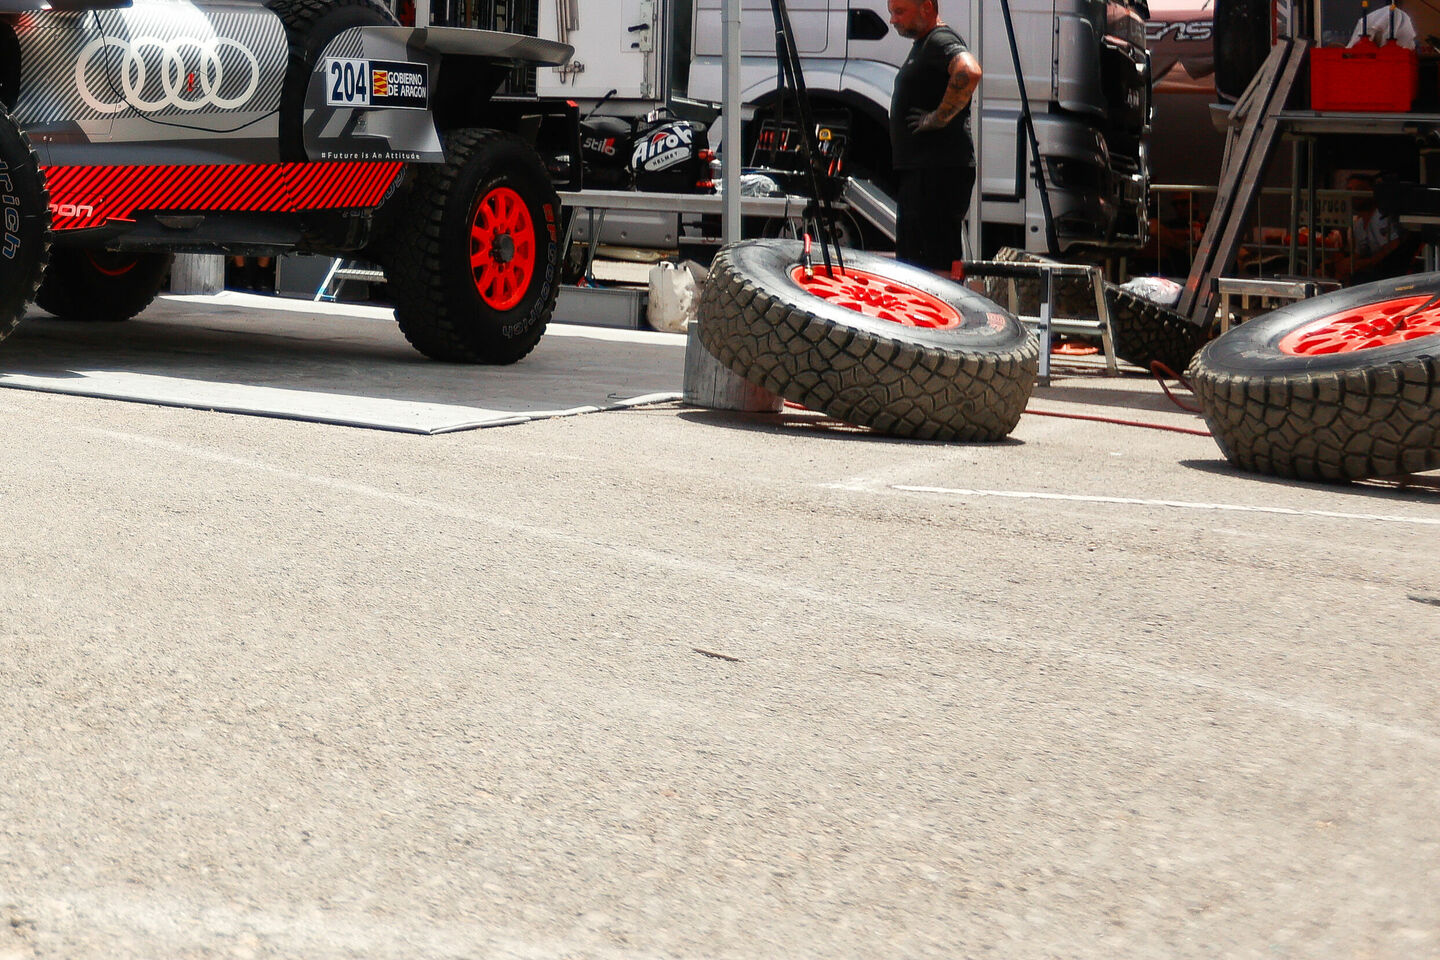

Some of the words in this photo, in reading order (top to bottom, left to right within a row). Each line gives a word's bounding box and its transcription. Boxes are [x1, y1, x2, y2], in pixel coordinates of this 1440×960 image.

[331, 61, 367, 102] 204
[388, 72, 423, 86] GOBIERNO
[388, 85, 399, 96] DE
[386, 152, 420, 160] Attitude
